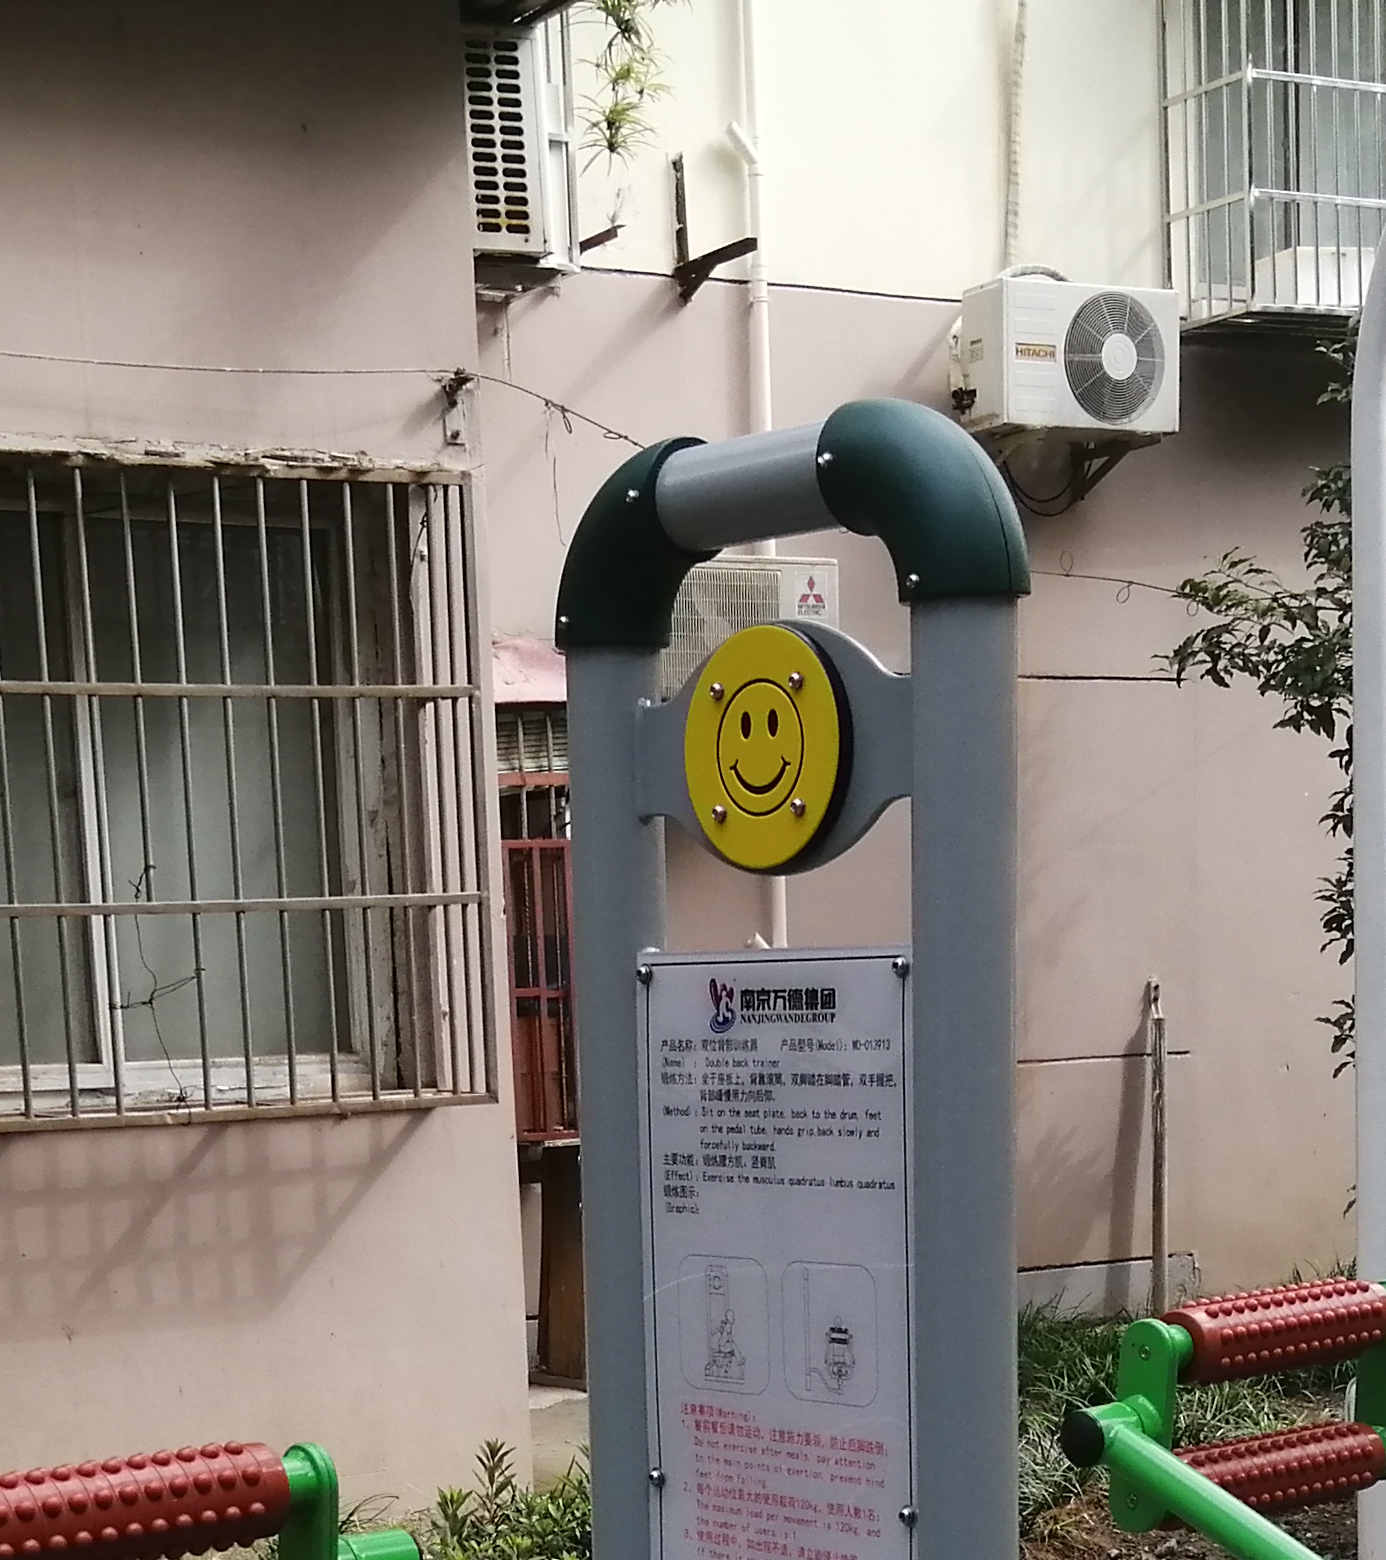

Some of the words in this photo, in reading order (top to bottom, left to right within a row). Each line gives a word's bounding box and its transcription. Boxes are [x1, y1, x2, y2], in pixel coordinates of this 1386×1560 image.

[1015, 346, 1056, 359] HITACHI
[739, 987, 837, 1012] 南京万德集团
[732, 1057, 749, 1069] back
[753, 1058, 781, 1069] trainer
[717, 1108, 726, 1118] on
[728, 1106, 741, 1118] the
[744, 1108, 761, 1119] seat
[791, 1107, 807, 1120] back
[812, 1109, 821, 1120] to
[824, 1107, 837, 1120] the
[865, 1108, 882, 1121] feet
[700, 1125, 708, 1134] on
[711, 1123, 724, 1134] the
[726, 1123, 747, 1136] pedal
[773, 1125, 794, 1136] hands
[837, 1126, 863, 1140] slowly
[866, 1127, 880, 1138] and
[700, 1138, 740, 1152] forcefully
[737, 1173, 750, 1184] the
